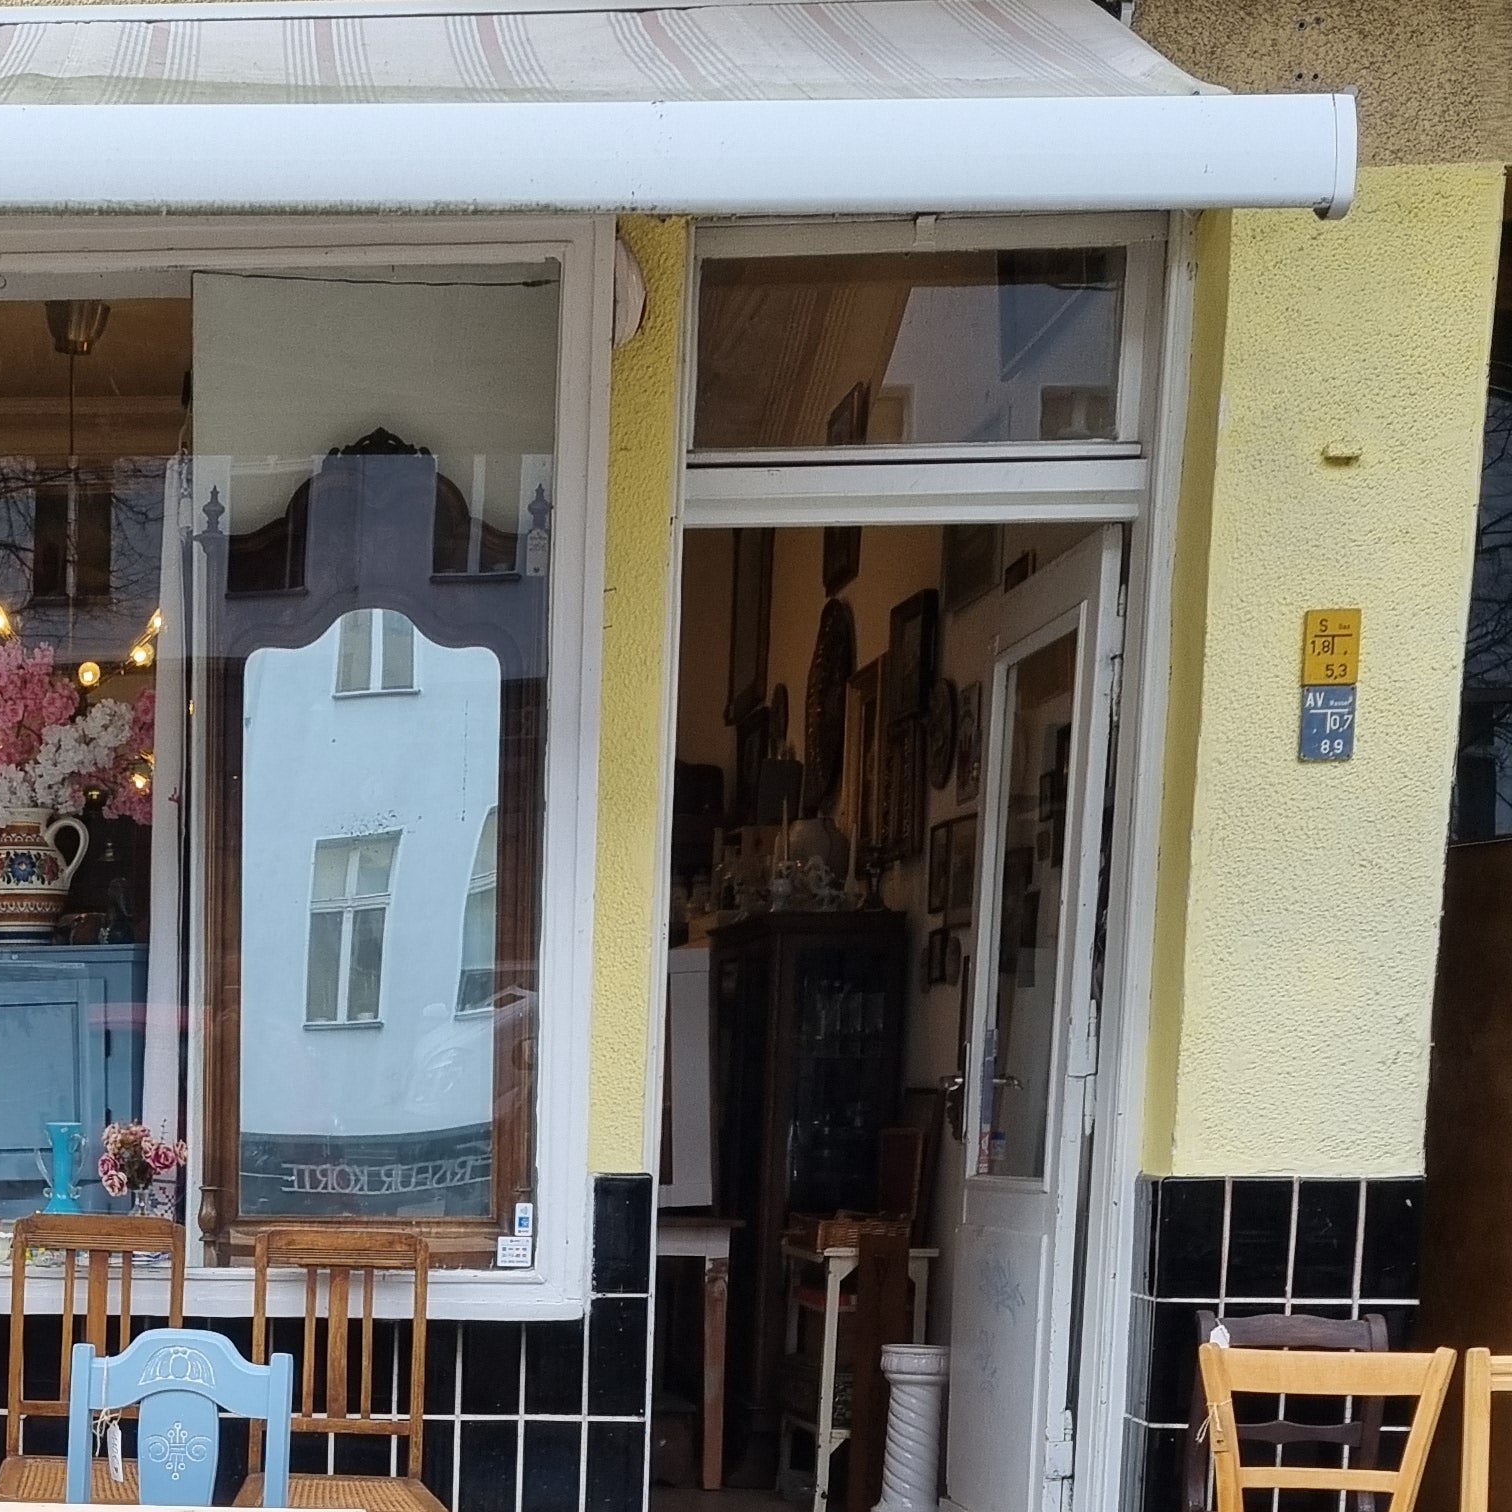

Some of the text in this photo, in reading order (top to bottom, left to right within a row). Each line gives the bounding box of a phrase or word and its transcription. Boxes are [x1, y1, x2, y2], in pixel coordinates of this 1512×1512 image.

[1319, 618, 1329, 632] S
[1310, 639, 1331, 656] 1,8
[1325, 663, 1348, 680] 5,3
[1304, 692, 1325, 708] AV
[1330, 714, 1353, 732] 0,7
[1320, 739, 1344, 757] 8,9
